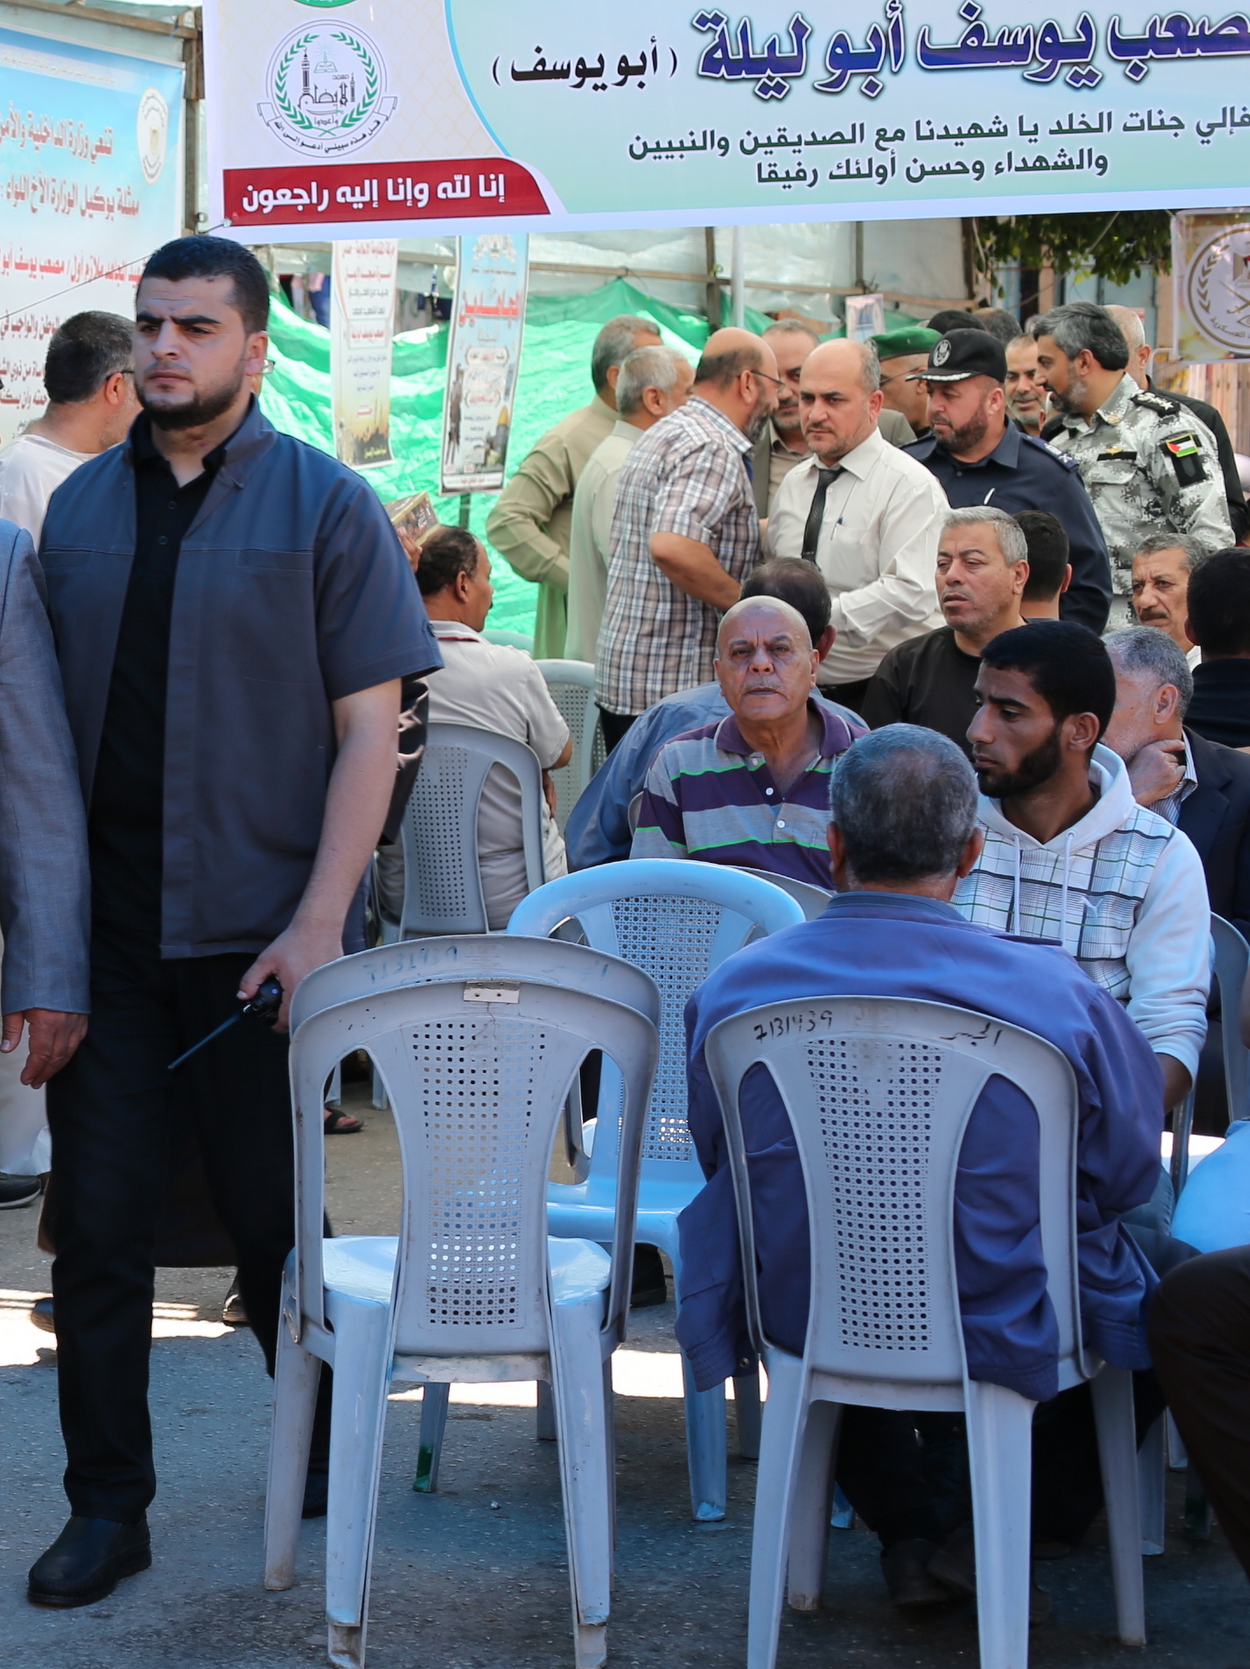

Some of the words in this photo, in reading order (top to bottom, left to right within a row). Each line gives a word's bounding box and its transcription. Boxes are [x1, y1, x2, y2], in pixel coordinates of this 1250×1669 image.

[691, 9, 812, 99] ليلة
[813, 0, 905, 97] أبو
[916, 0, 1102, 88] يوسف
[1107, 11, 1250, 83] صعب
[28, 110, 67, 151] الداخلية
[67, 118, 90, 159] وزارة
[739, 121, 866, 155] الصديقين
[874, 126, 907, 151] مع
[914, 114, 1009, 147] شهيدنا
[1017, 114, 1040, 144] يا
[1048, 110, 1113, 136] الخلد
[1122, 108, 1186, 138] جنات
[628, 128, 731, 161] والنبيين
[756, 160, 819, 191] رفيقا
[827, 148, 898, 185] أولئك
[905, 157, 985, 184] وحسن
[993, 146, 1110, 177] والشهداء
[50, 177, 79, 215] الوزارة
[241, 181, 330, 214] راجعون
[336, 178, 380, 209] إليه
[386, 176, 430, 208] وإنا
[478, 173, 506, 203] إنا
[14, 245, 39, 282] يوسف
